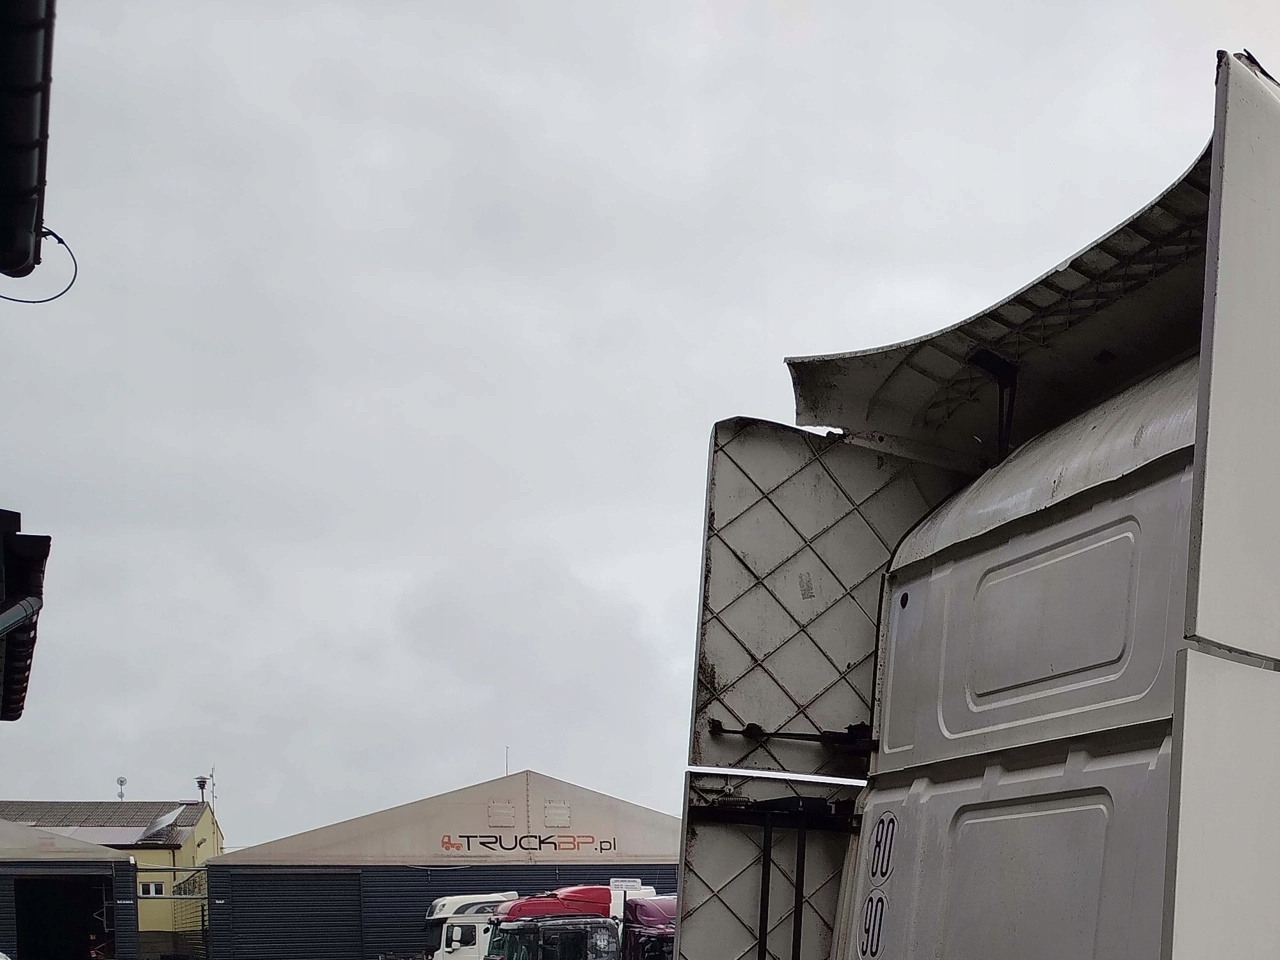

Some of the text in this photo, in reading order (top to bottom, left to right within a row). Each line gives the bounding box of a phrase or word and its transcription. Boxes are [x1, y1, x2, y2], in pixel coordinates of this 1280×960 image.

[458, 834, 616, 853] TRUCKBP.pl
[871, 817, 895, 878] 80
[862, 896, 884, 957] 90
